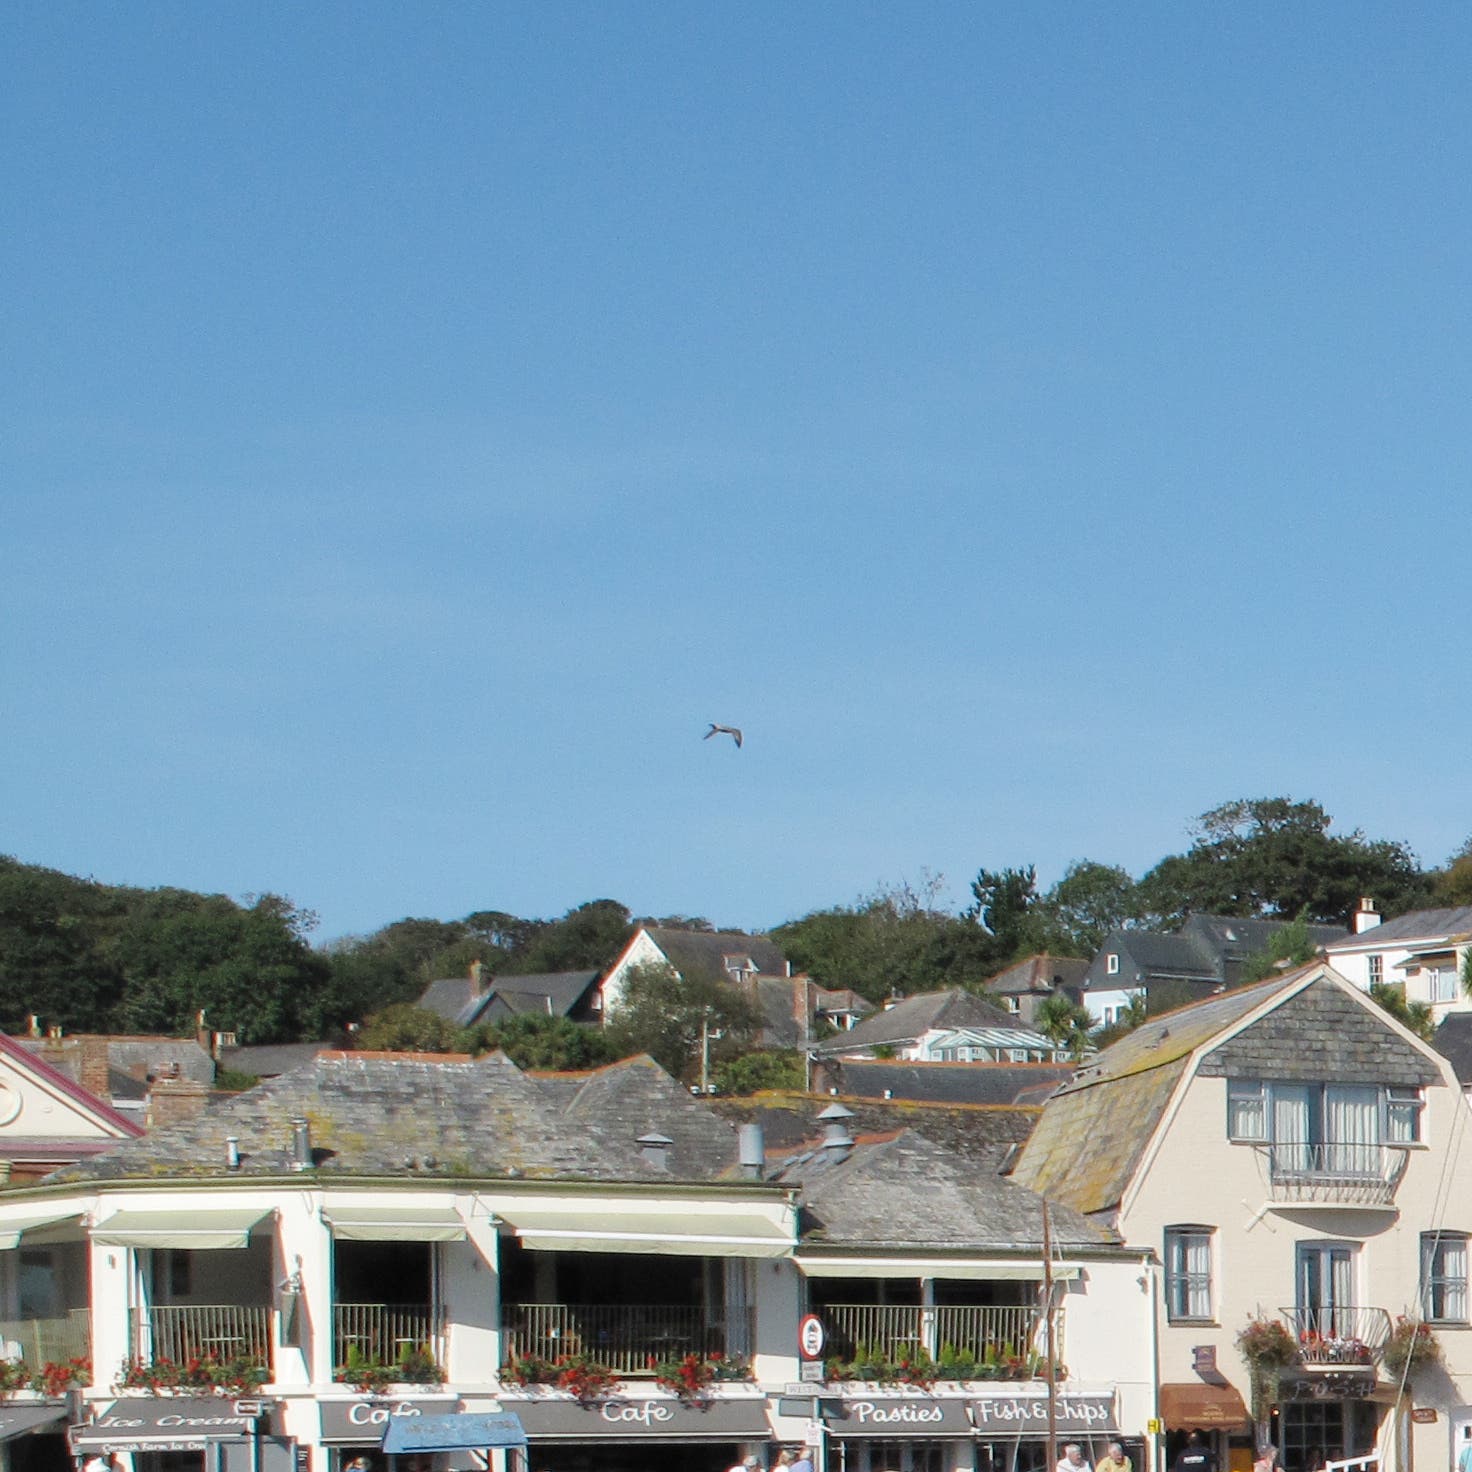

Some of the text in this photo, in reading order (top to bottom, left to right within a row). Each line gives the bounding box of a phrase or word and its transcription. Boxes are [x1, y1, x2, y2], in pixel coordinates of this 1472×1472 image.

[99, 1415, 247, 1428] Ice Cream
[602, 1400, 674, 1426] Cafe
[852, 1402, 944, 1423] Pasties
[977, 1400, 1031, 1423] Fish
